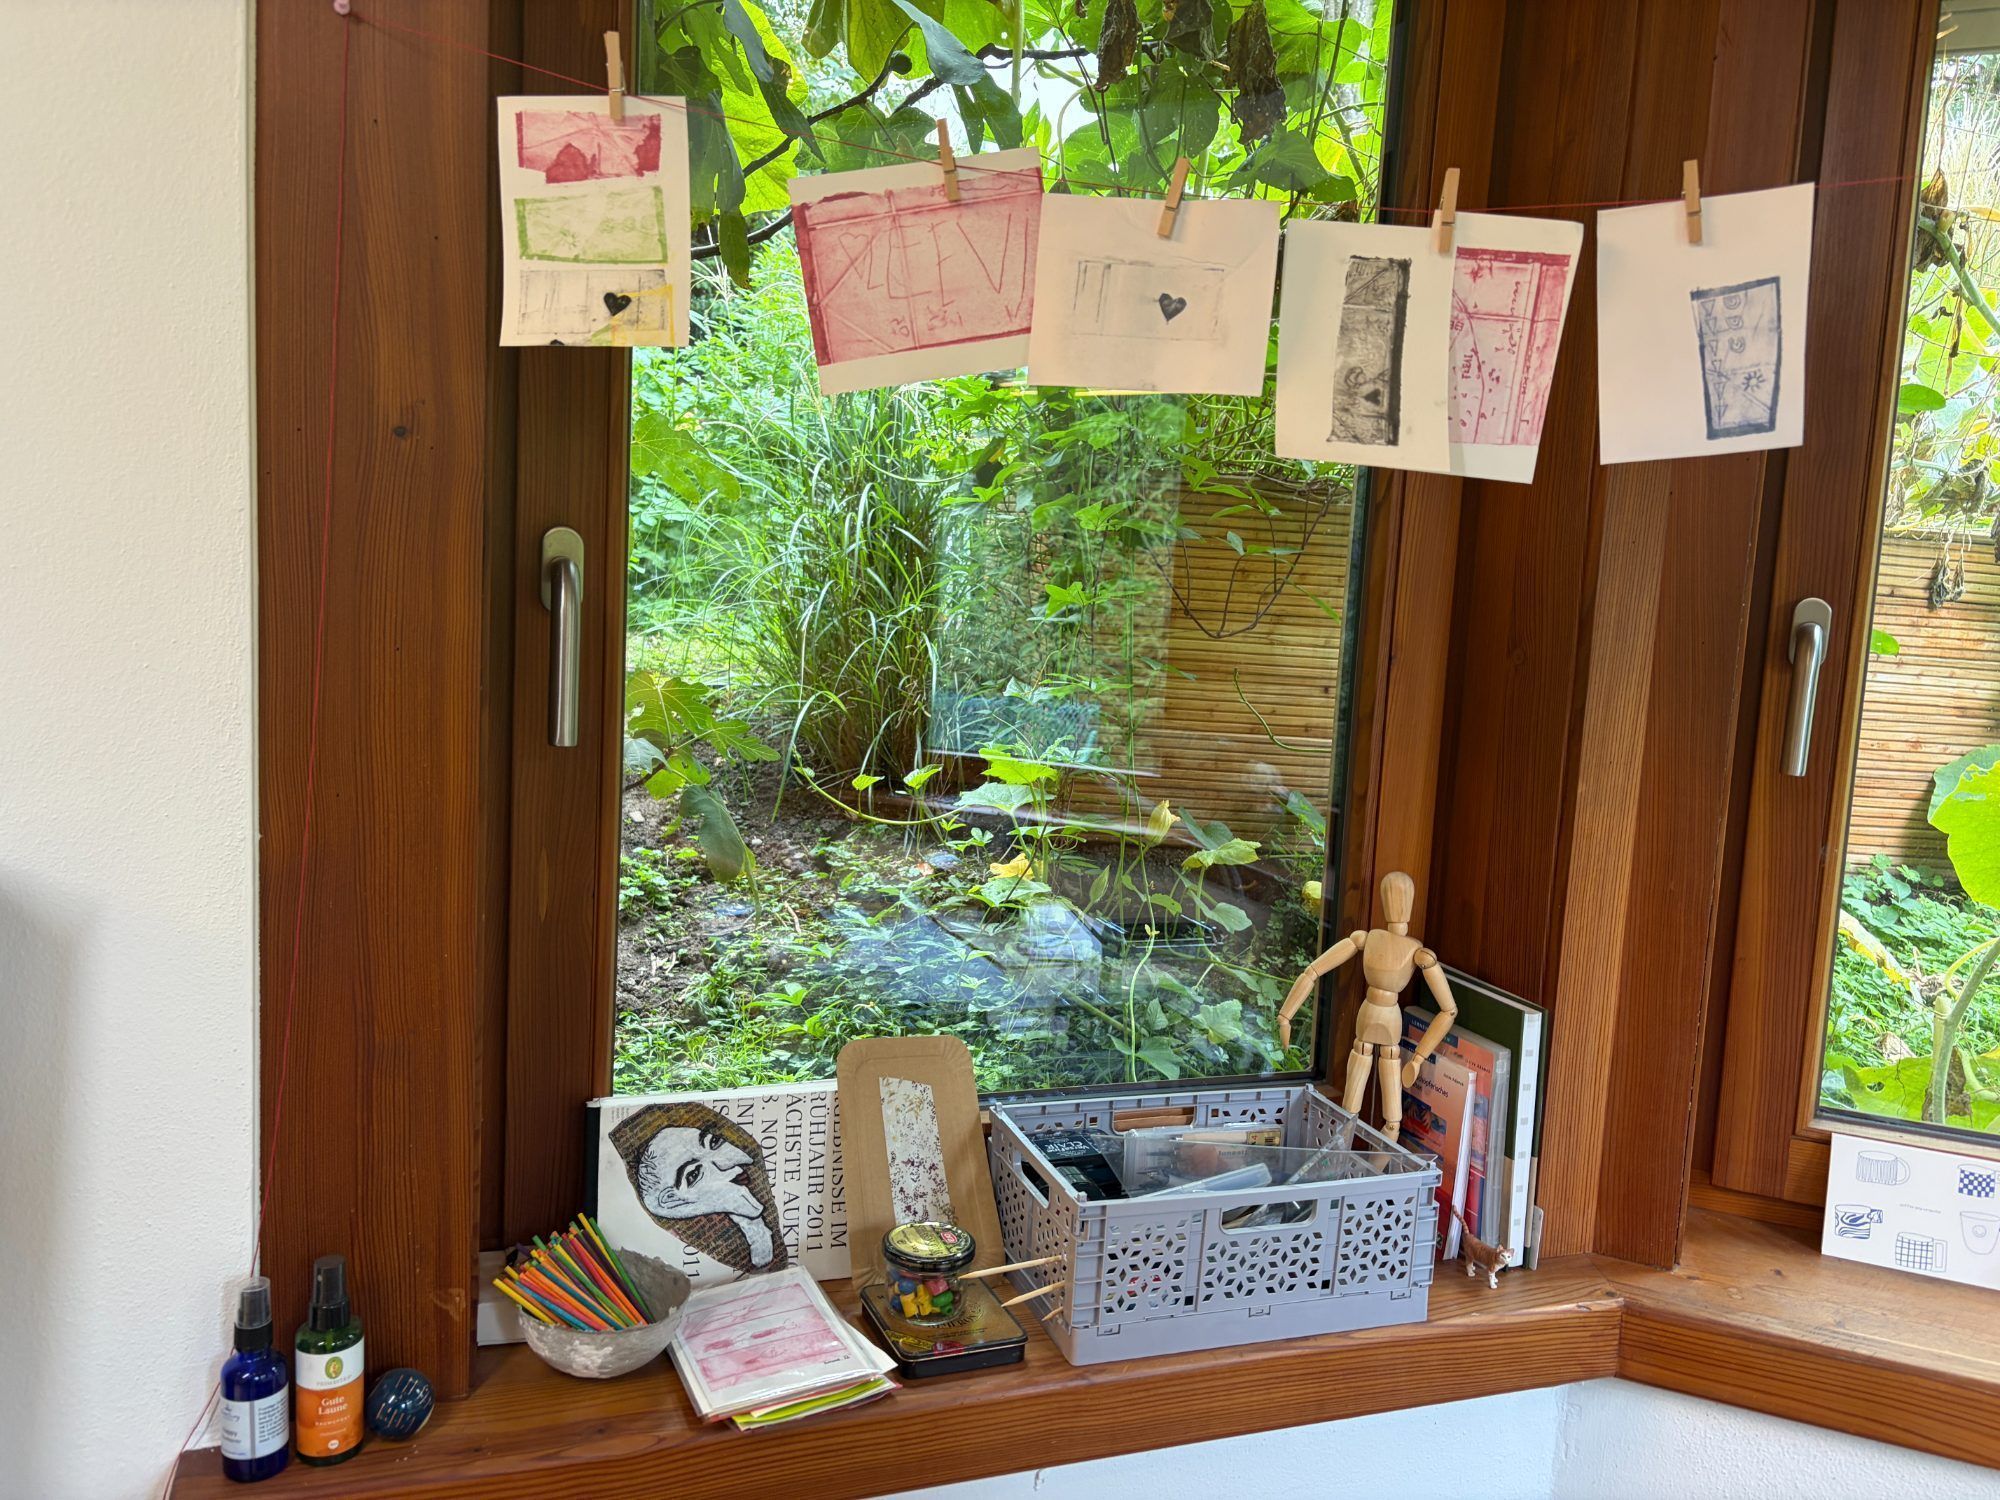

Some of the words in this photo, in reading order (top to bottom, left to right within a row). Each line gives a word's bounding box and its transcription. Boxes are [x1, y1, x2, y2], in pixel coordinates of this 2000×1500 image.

[806, 1204, 824, 1254] 2011
[831, 1222, 847, 1249] IM
[318, 1403, 349, 1415] Laune
[321, 1395, 345, 1406] Gute
